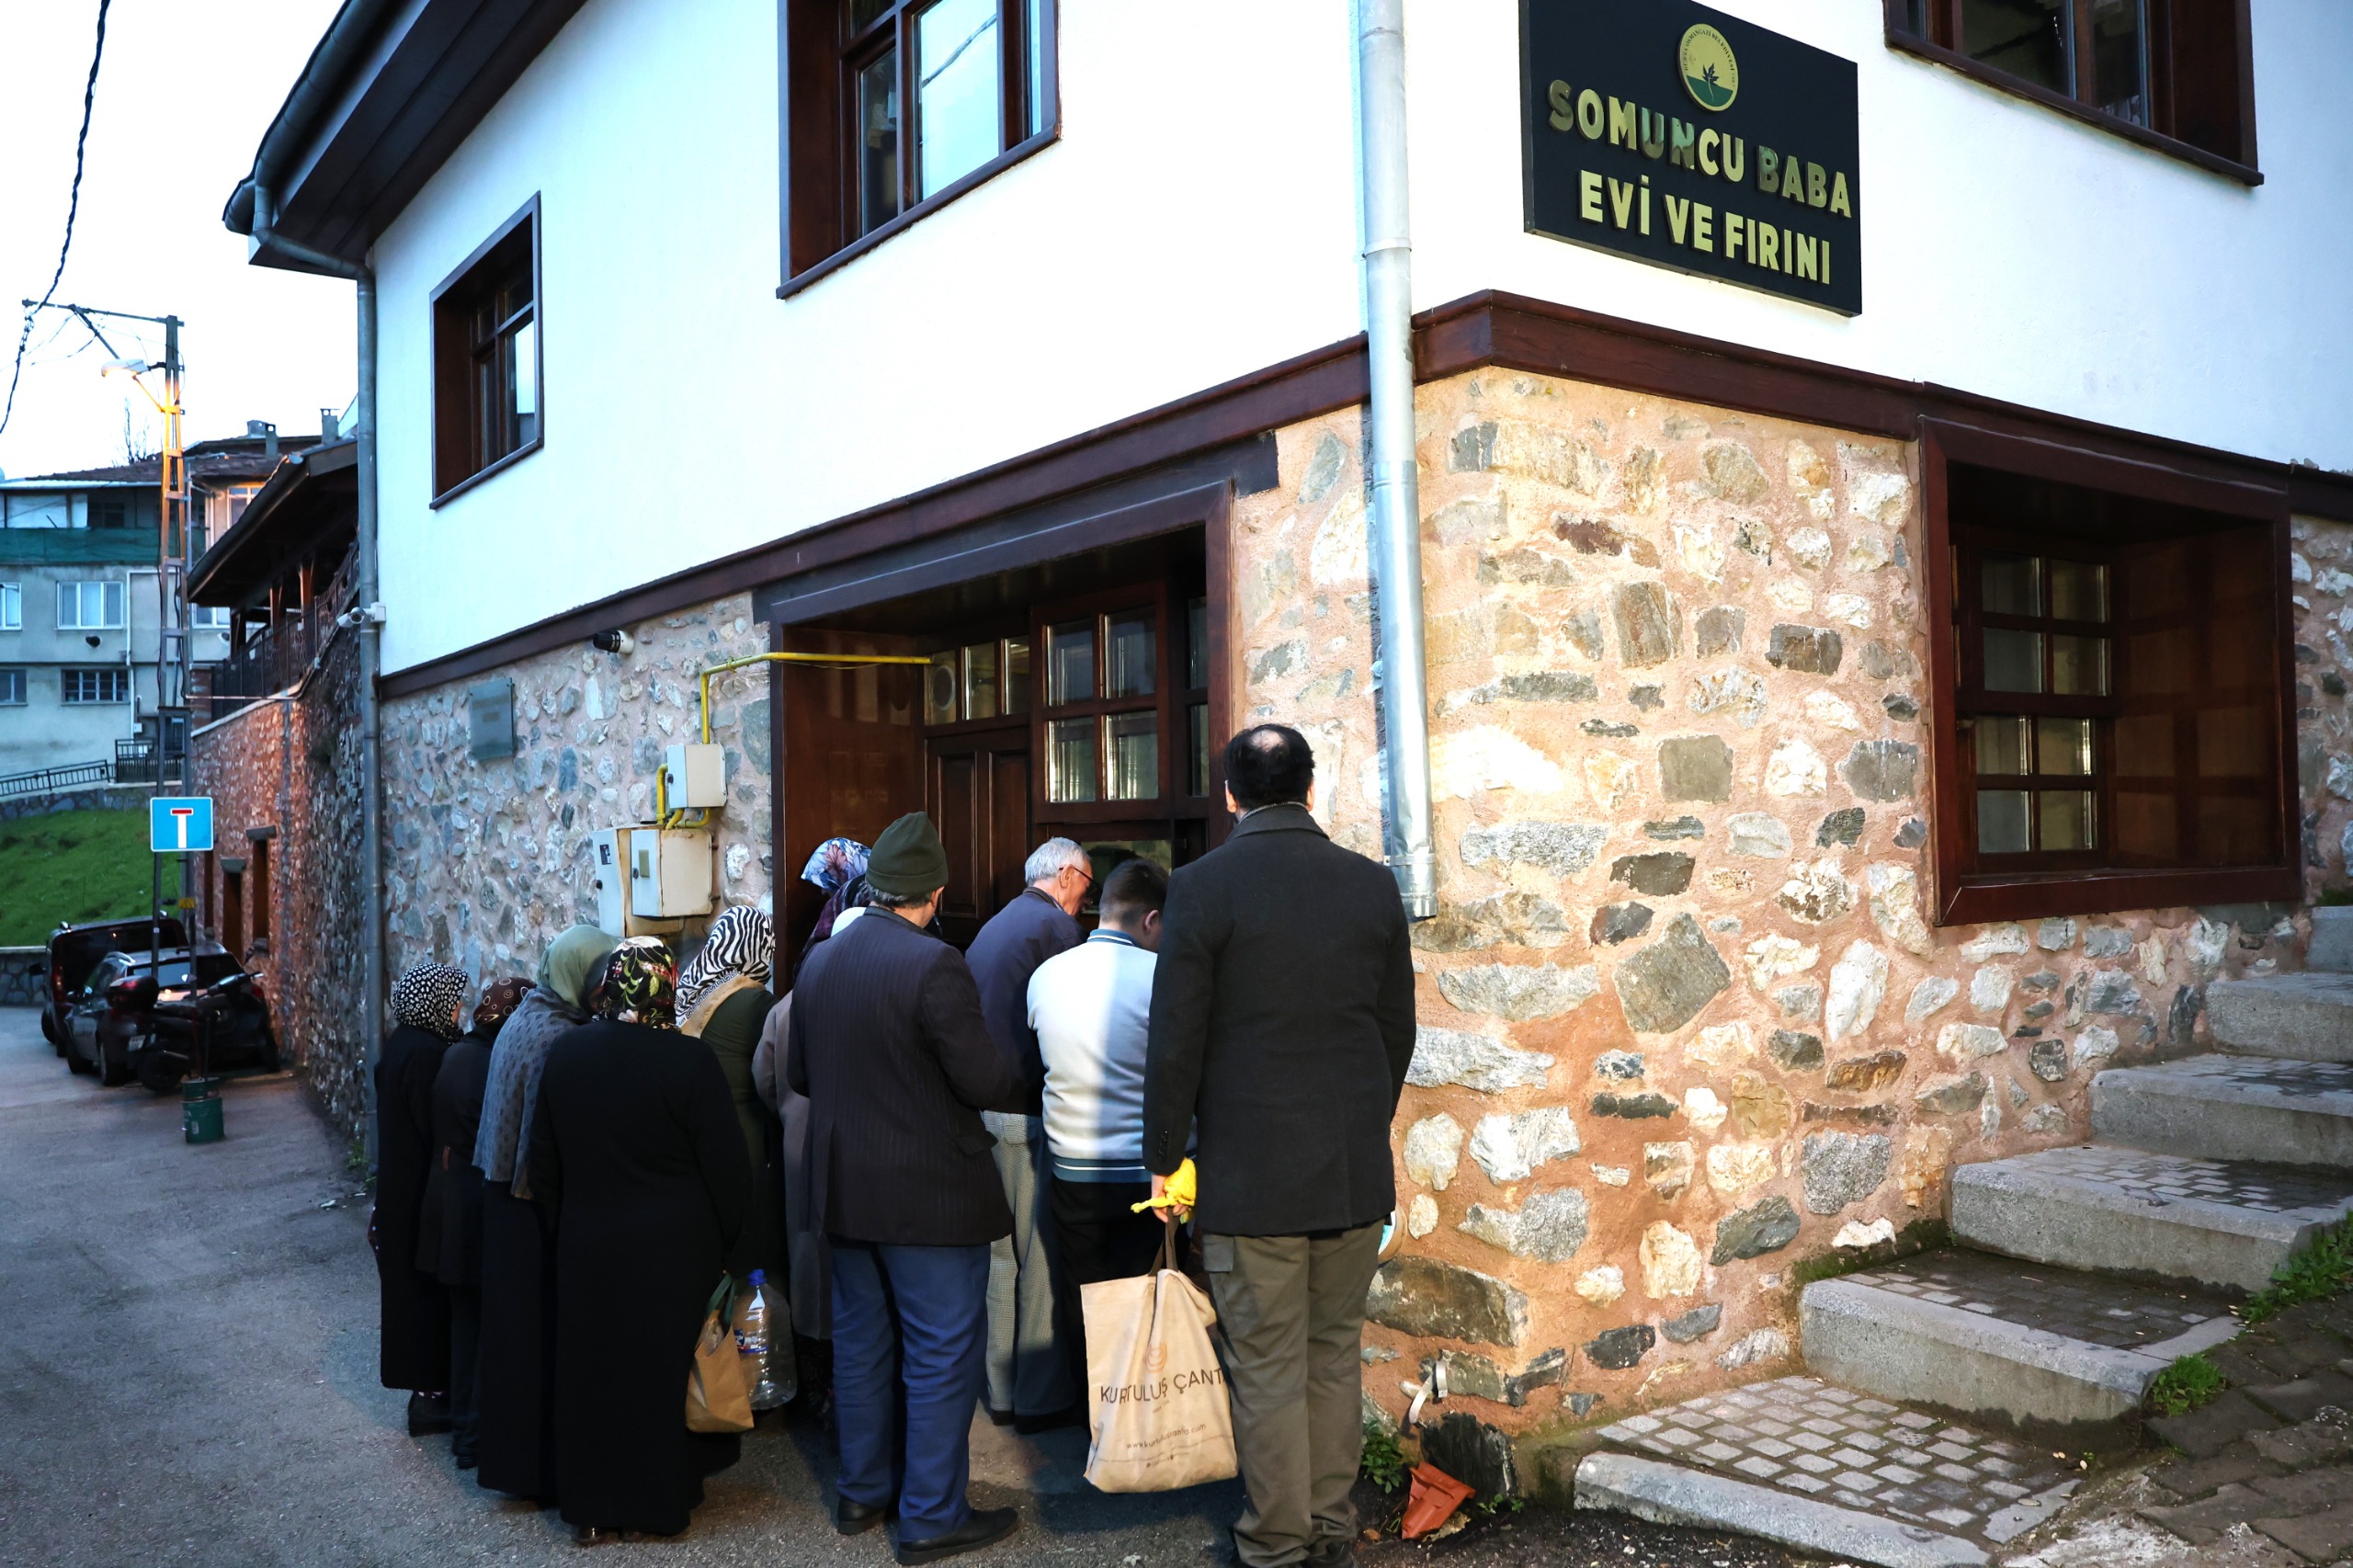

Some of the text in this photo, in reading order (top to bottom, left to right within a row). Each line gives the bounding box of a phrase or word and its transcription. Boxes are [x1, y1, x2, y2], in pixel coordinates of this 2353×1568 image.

[1548, 79, 1851, 218] SOMUNCU BABA
[1663, 194, 1713, 253] VE
[1723, 211, 1830, 285] FIRINI
[1100, 1368, 1225, 1404] KURTULUŞ ÇANT
